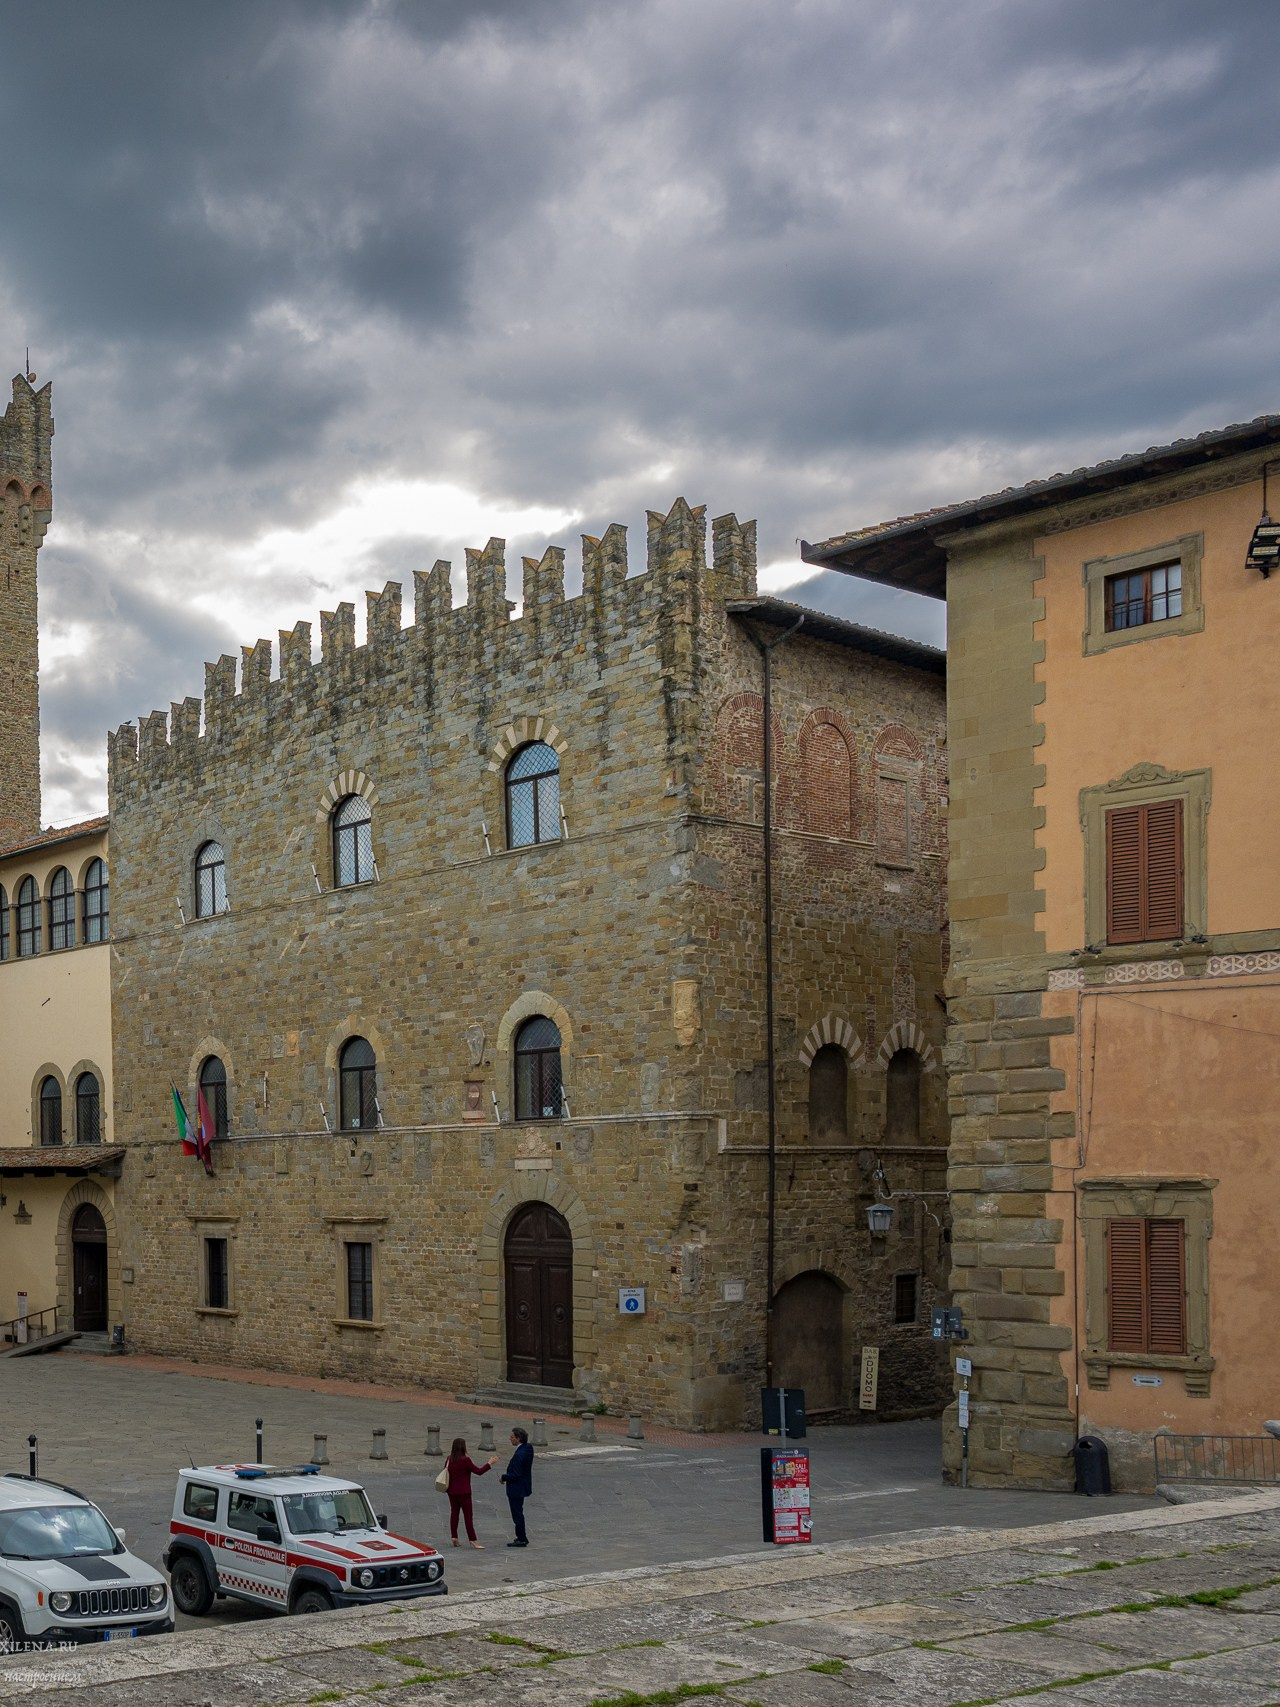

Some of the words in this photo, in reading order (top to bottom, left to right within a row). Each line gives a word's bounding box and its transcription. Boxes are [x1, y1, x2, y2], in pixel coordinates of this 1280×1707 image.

[865, 1360, 873, 1392] DUOMO
[235, 1541, 253, 1554] POLIZIA
[253, 1546, 285, 1563] PROVINCIALE
